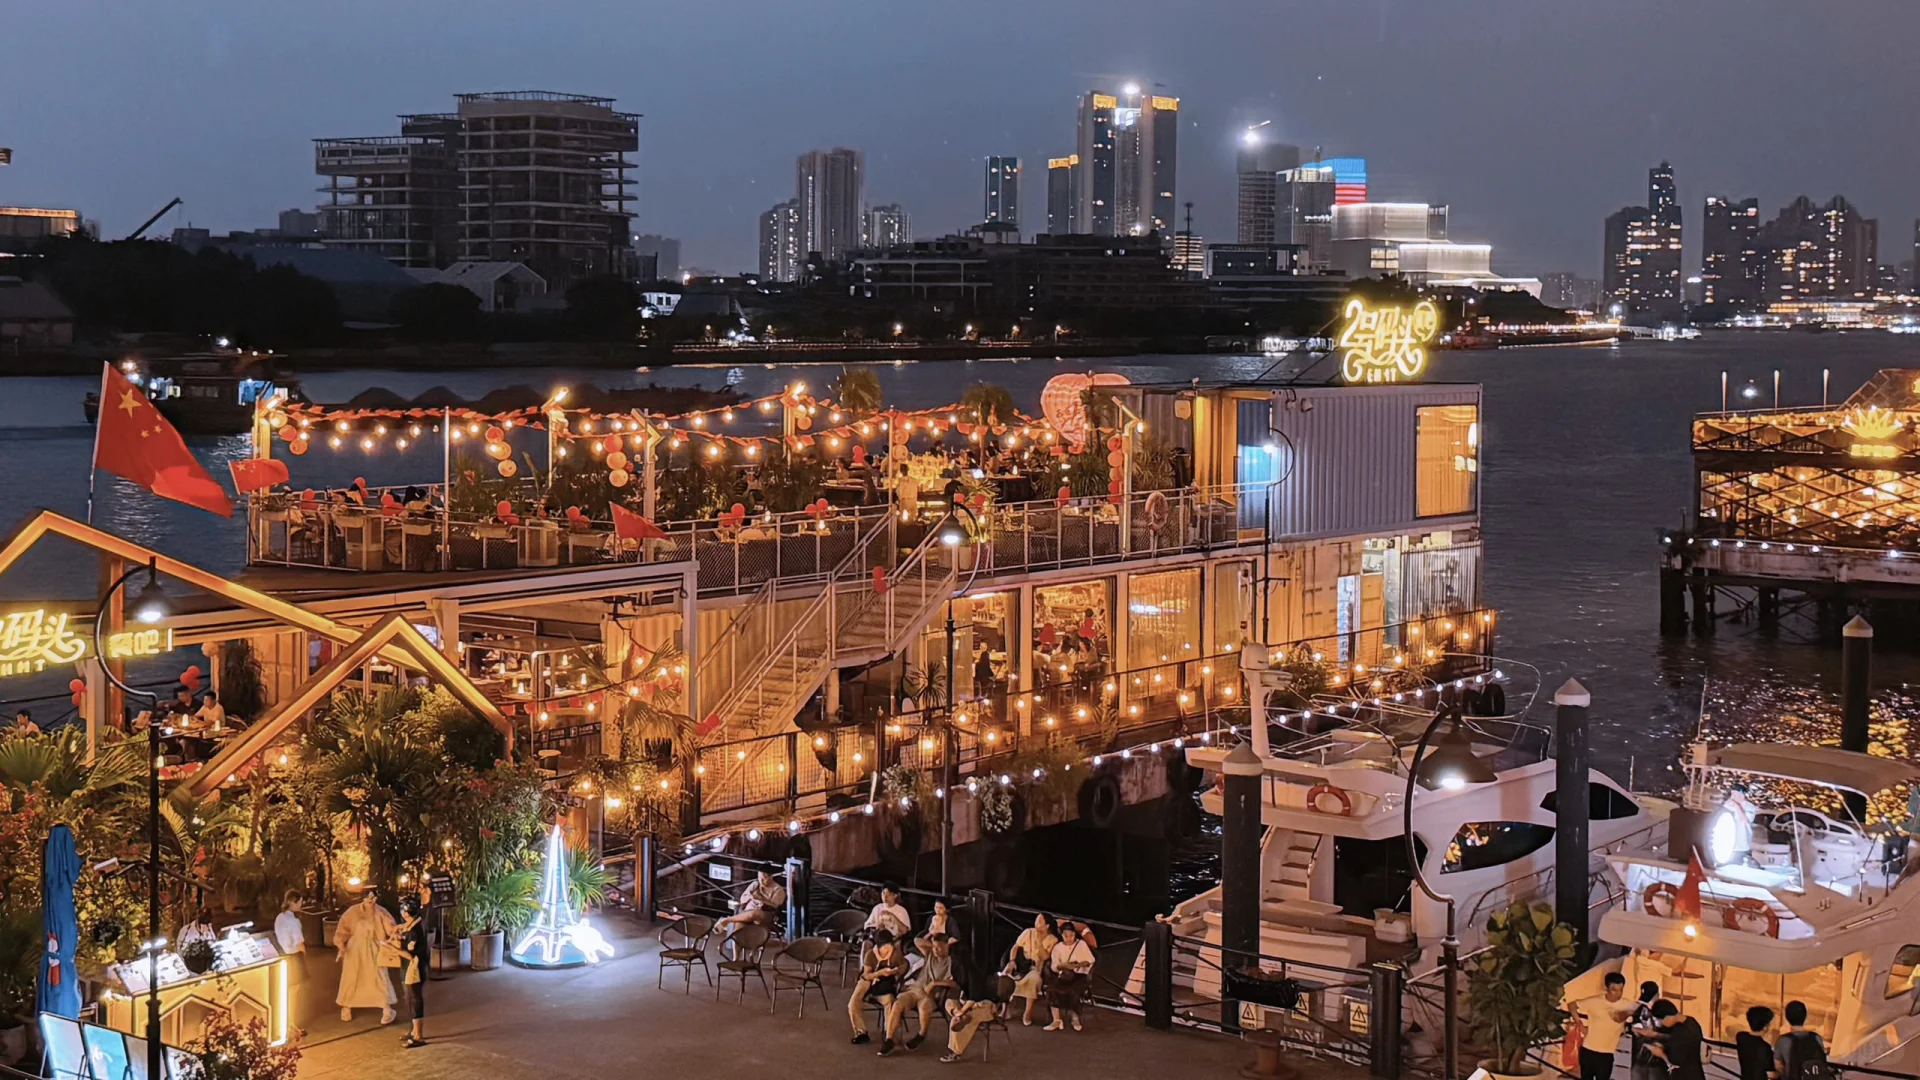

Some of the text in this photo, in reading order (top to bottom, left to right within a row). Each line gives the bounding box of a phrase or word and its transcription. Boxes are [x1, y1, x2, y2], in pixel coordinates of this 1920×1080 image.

[1340, 299, 1422, 377] 2号码头
[0, 609, 86, 663] 码头
